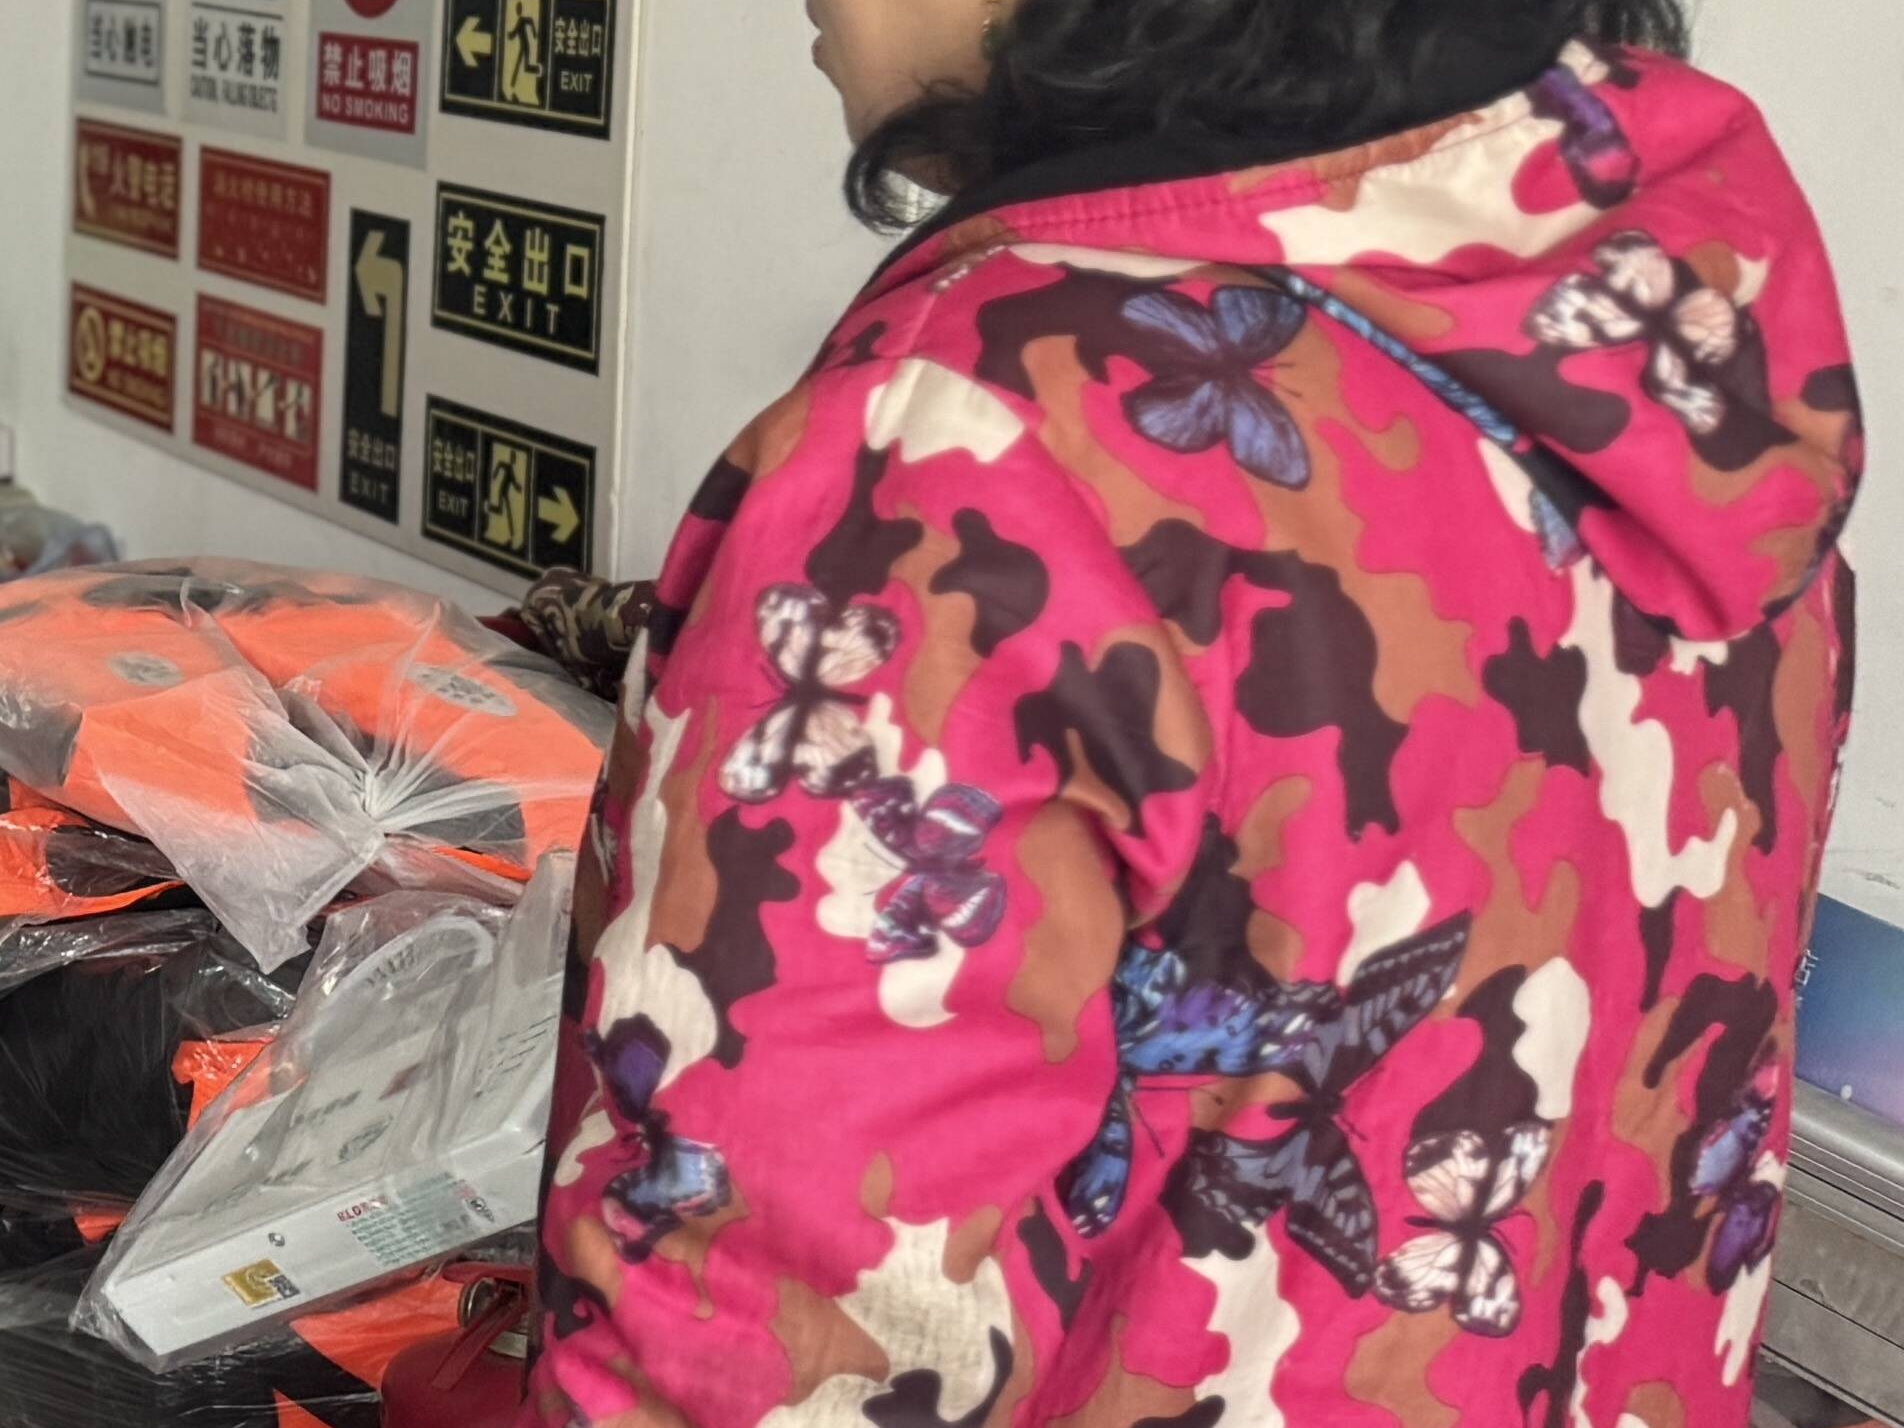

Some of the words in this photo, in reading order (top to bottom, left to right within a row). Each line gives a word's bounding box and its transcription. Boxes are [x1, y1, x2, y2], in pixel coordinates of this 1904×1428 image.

[191, 17, 280, 81] 当心落物
[554, 16, 602, 60] 安全出口
[322, 41, 411, 97] 禁止吸烟
[559, 70, 593, 94] EXIT
[321, 93, 340, 112] NO
[345, 97, 409, 125] SMOKING
[445, 210, 591, 301] 安全出口
[472, 284, 561, 336] EXIT
[347, 426, 396, 470] 安全出口
[432, 436, 475, 480] 安全出口
[348, 472, 388, 505] EXIT
[438, 490, 470, 518] EXIT
